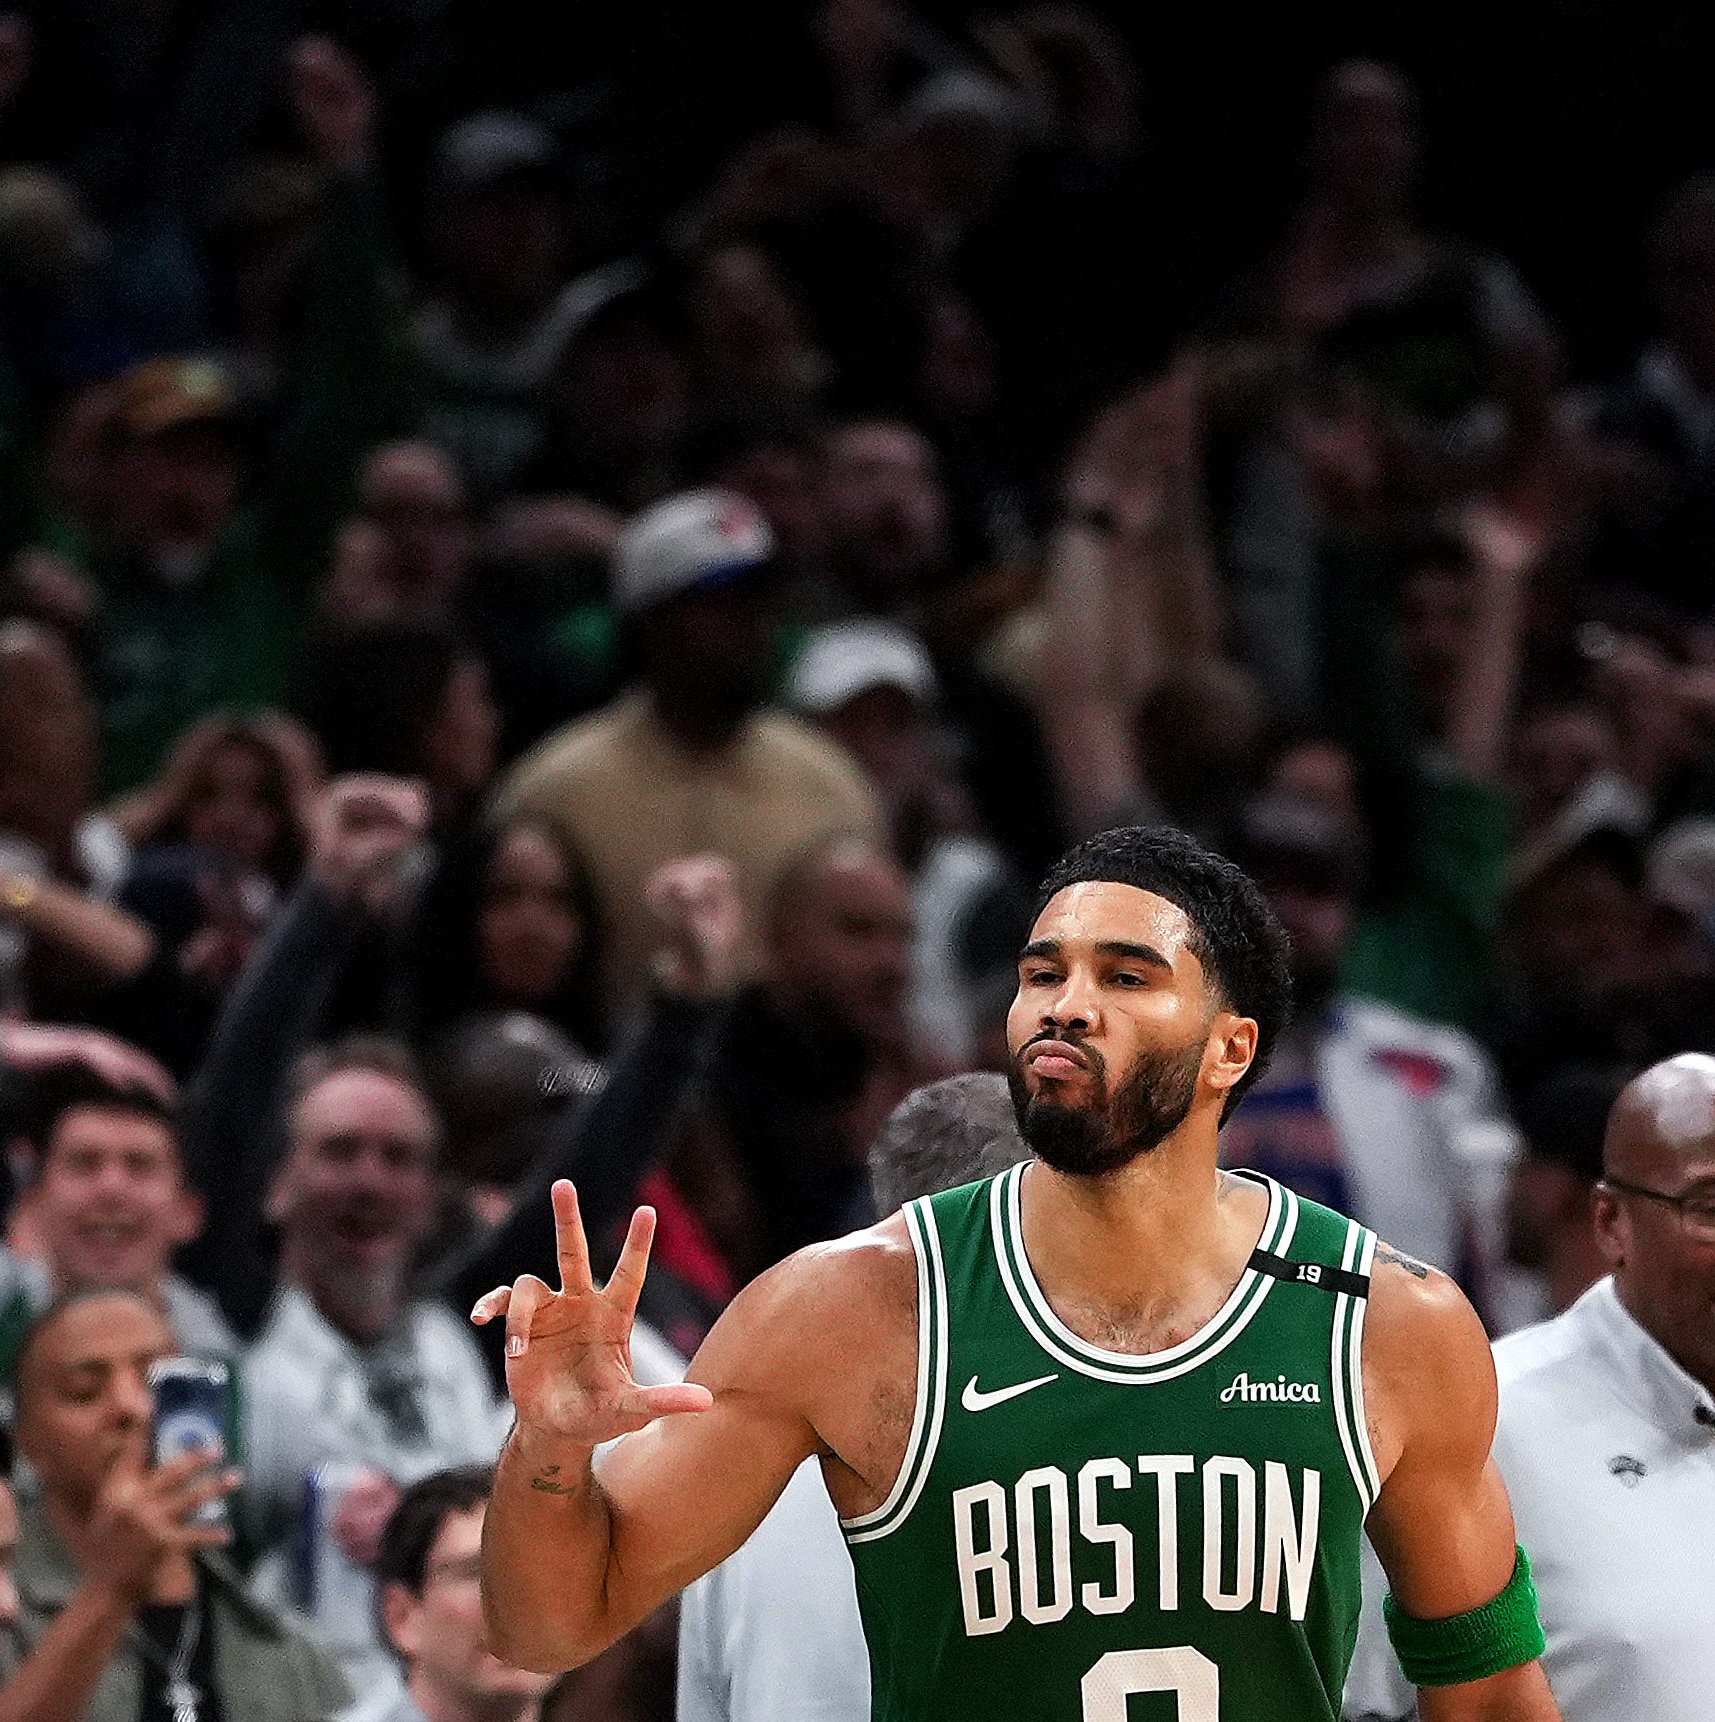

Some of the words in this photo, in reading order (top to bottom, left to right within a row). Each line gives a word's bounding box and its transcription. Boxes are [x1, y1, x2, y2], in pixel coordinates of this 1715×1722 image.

[1296, 1265, 1322, 1284] 19
[1220, 1372, 1321, 1403] Amica
[953, 1454, 1321, 1637] BOSTON
